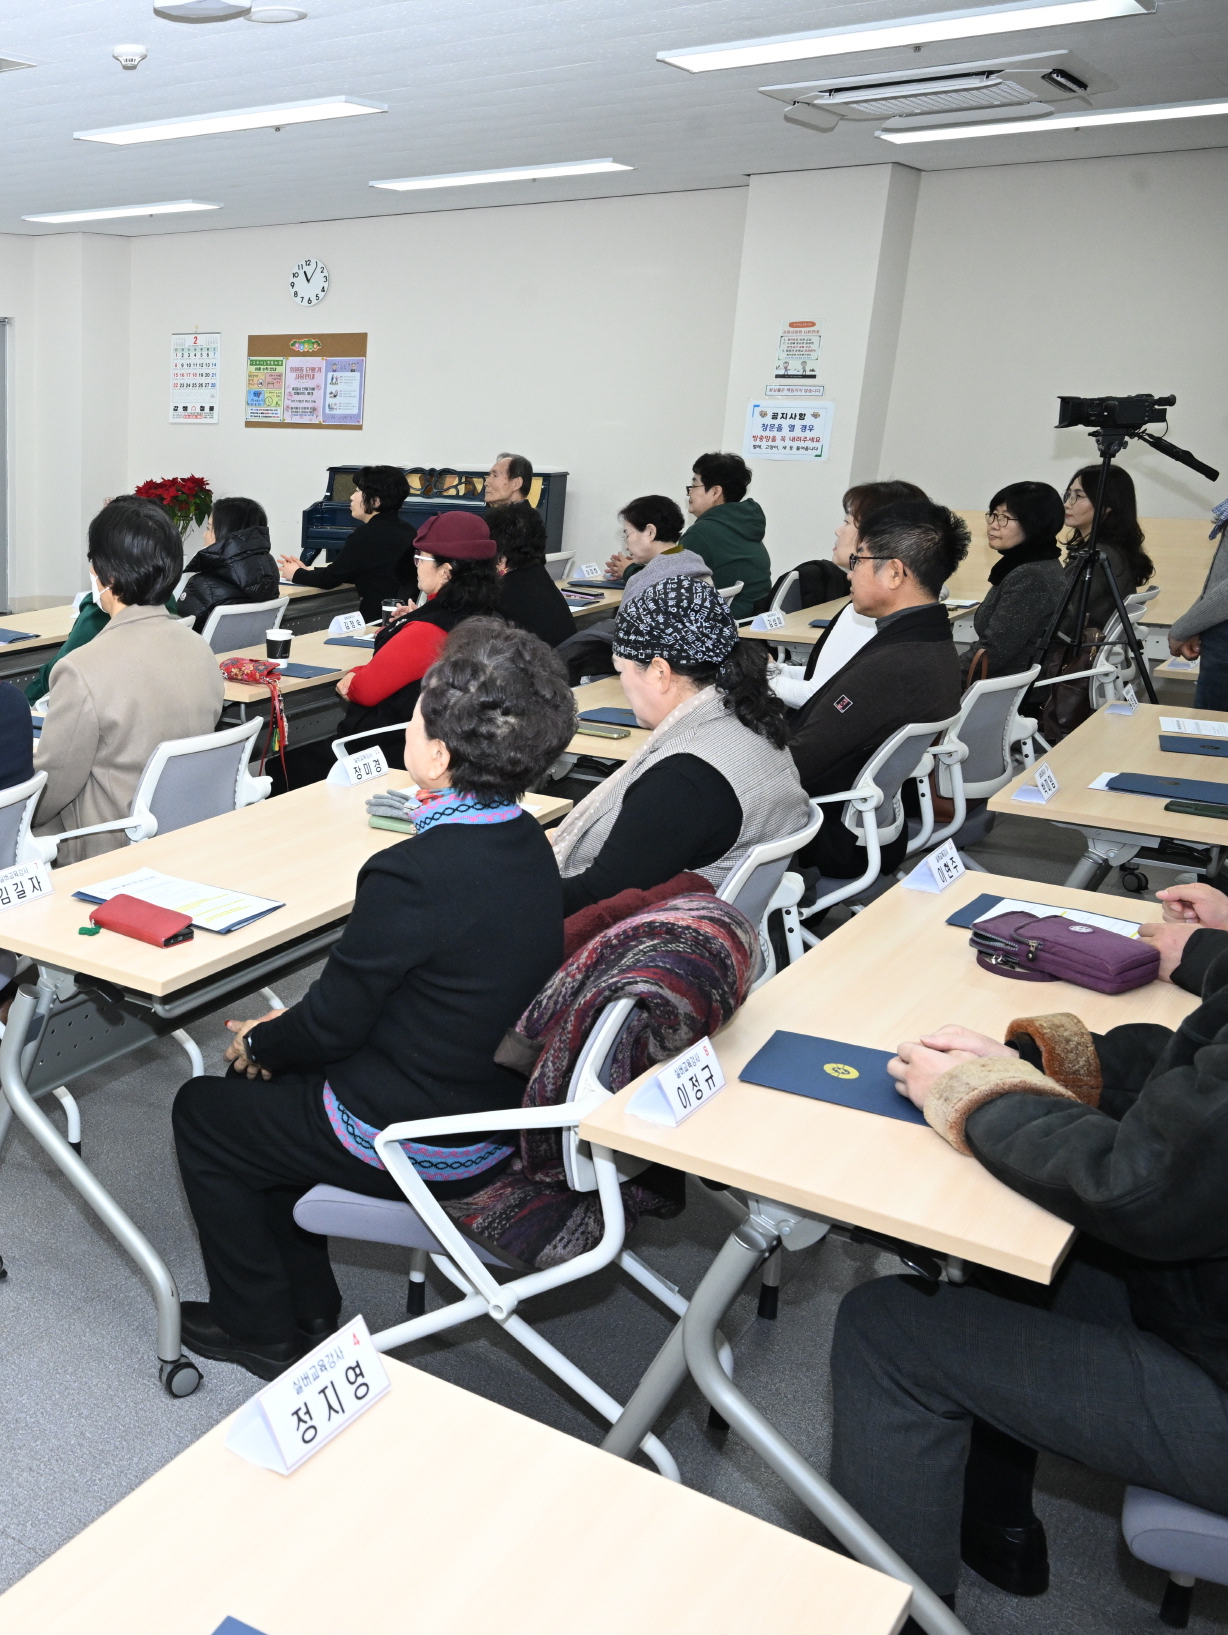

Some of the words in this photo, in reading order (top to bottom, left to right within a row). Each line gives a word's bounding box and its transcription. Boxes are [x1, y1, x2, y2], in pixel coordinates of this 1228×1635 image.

[193, 336, 198, 344] 2
[771, 412, 806, 420] 공지사항
[761, 423, 783, 432] 창문을
[800, 424, 814, 432] 경우
[677, 1064, 716, 1109] 이정규
[352, 1333, 360, 1346] 4
[292, 1346, 345, 1395] 실버교육강사
[291, 1360, 369, 1444] 정지영
